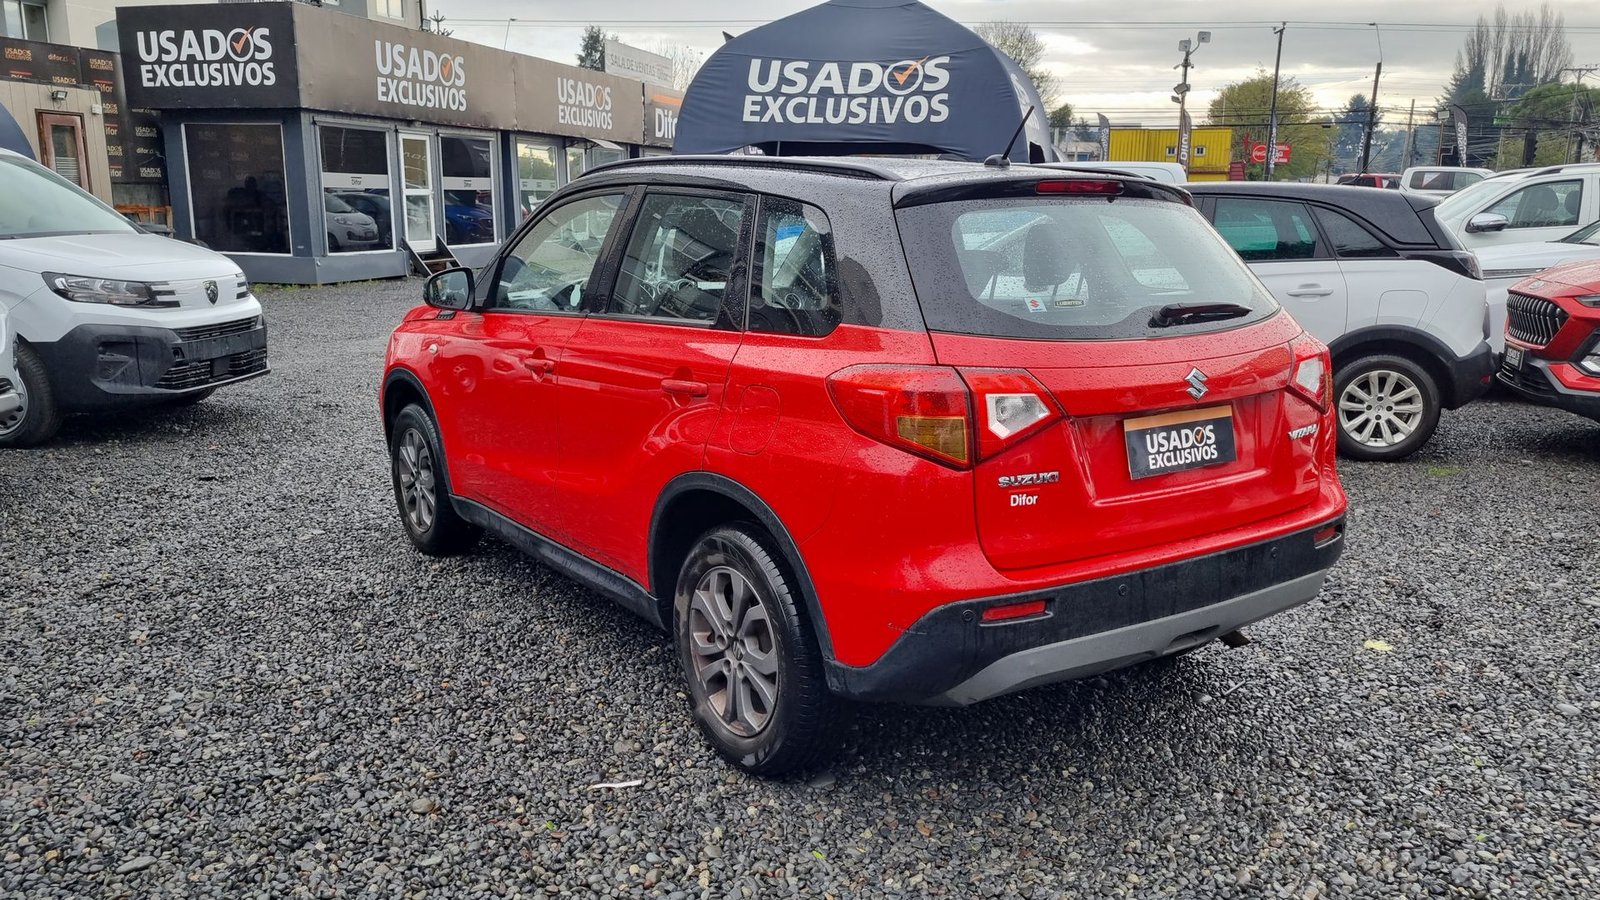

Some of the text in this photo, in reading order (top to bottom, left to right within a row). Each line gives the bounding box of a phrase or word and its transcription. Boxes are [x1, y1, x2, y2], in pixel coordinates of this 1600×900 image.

[137, 27, 273, 62] USADOS
[140, 62, 276, 87] EXCLUSIVOS
[375, 40, 465, 86] USADOS
[748, 56, 950, 95] USADOS
[377, 77, 467, 111] EXCLUSIVOS
[557, 77, 611, 110] USADOS
[742, 93, 949, 124] EXCLUSIVOS
[105, 127, 117, 135] ifor
[558, 105, 613, 130] EXCLUSIVOS
[1146, 424, 1216, 454] USADOS
[1148, 444, 1218, 469] EXCLUSIVOS
[998, 471, 1059, 487] SUZUKI
[1010, 494, 1038, 507] Difor
